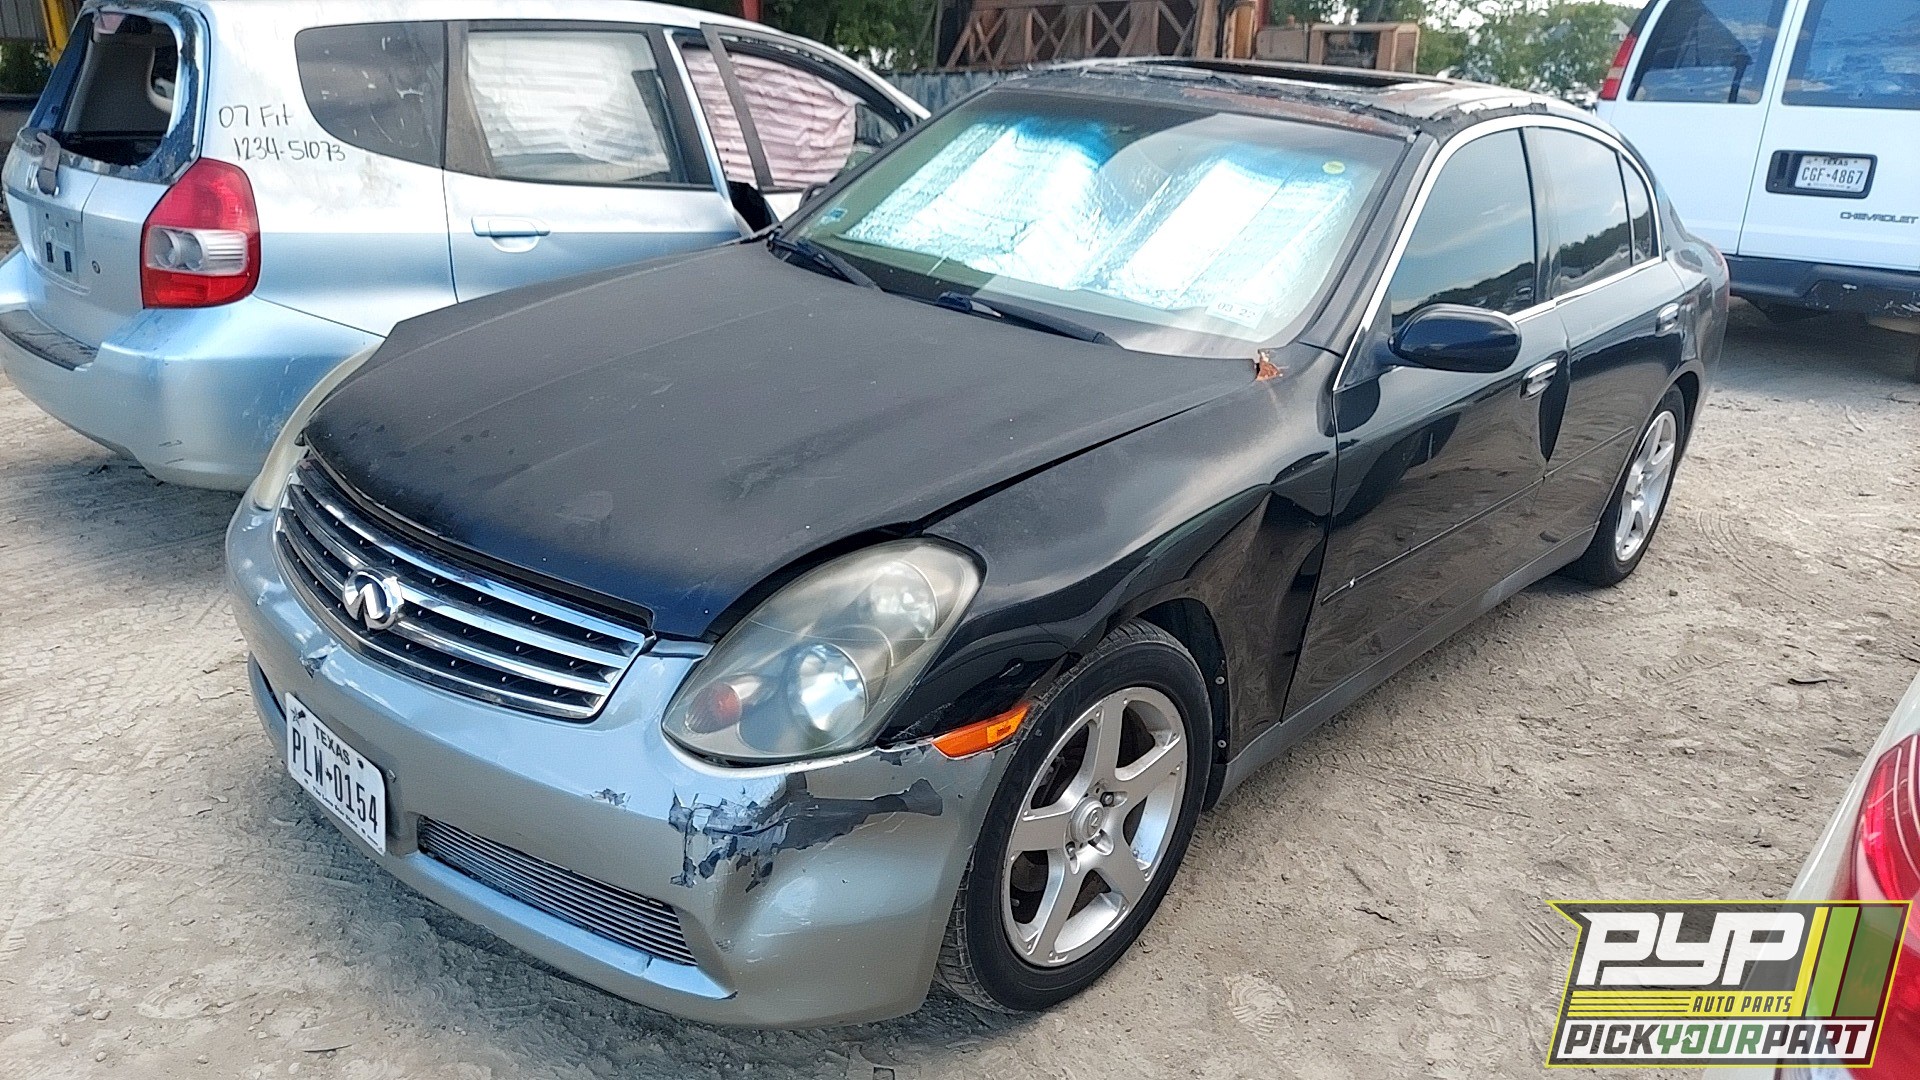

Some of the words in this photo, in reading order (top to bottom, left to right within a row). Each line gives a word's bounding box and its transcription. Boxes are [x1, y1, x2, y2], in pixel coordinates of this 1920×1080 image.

[218, 106, 249, 128] 07
[260, 103, 293, 127] Fit
[233, 137, 345, 161] 1234-51073
[1822, 158, 1849, 166] TEXAS
[1840, 212, 1919, 224] CHEVROLET
[313, 722, 350, 766] TEXAS
